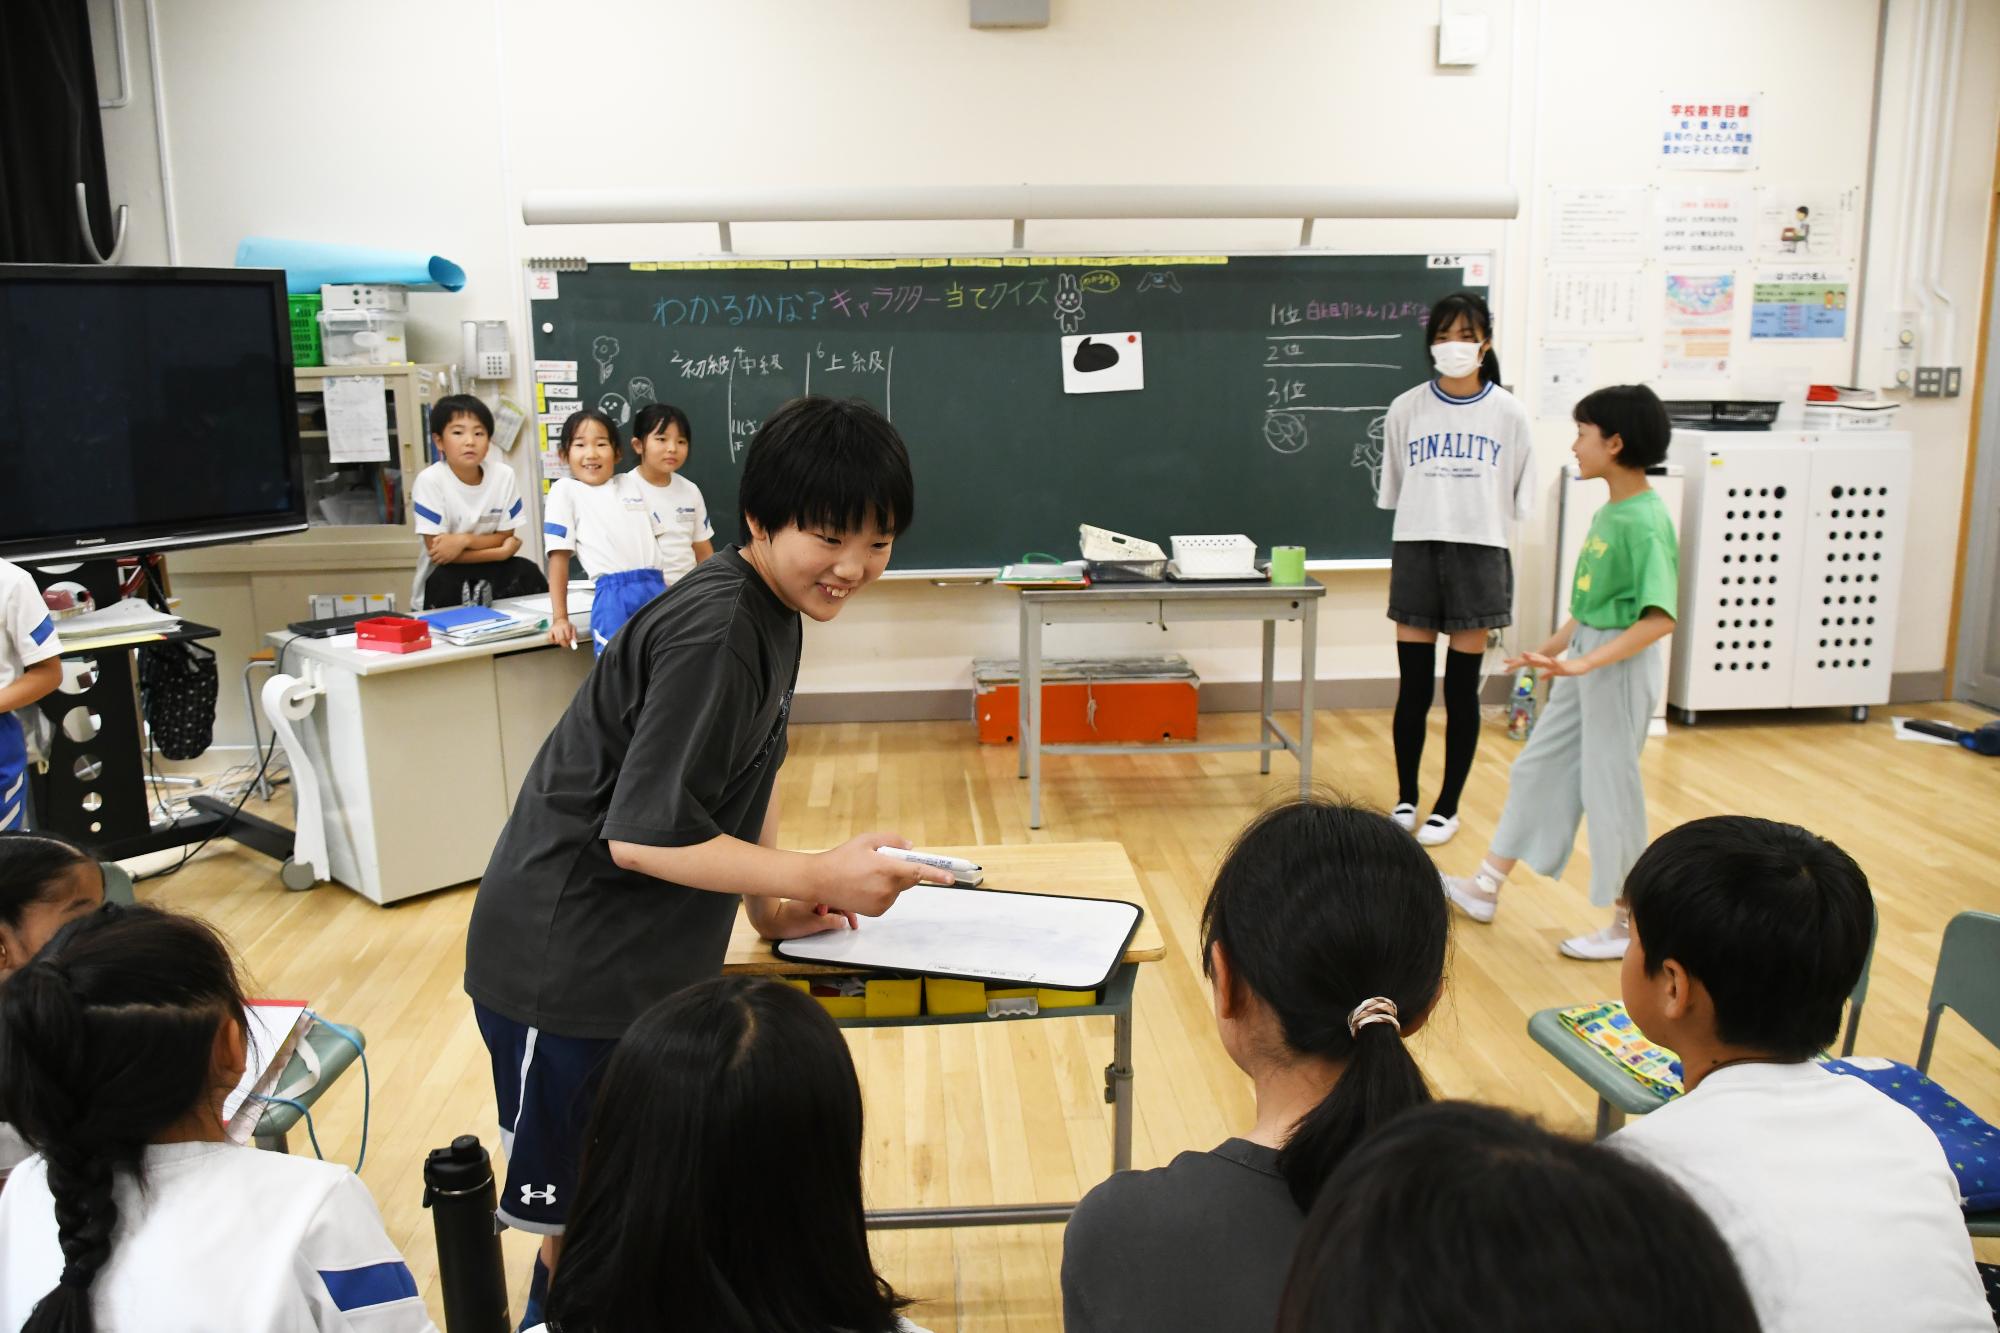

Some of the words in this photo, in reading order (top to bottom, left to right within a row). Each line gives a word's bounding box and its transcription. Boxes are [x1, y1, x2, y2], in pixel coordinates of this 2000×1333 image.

[1671, 104, 1750, 118] 学校教育目標
[536, 275, 551, 290] 左
[1266, 343, 1305, 362] 2位
[552, 387, 570, 396] こくご
[1266, 378, 1307, 408] 3位
[1408, 432, 1502, 467] FINALITY
